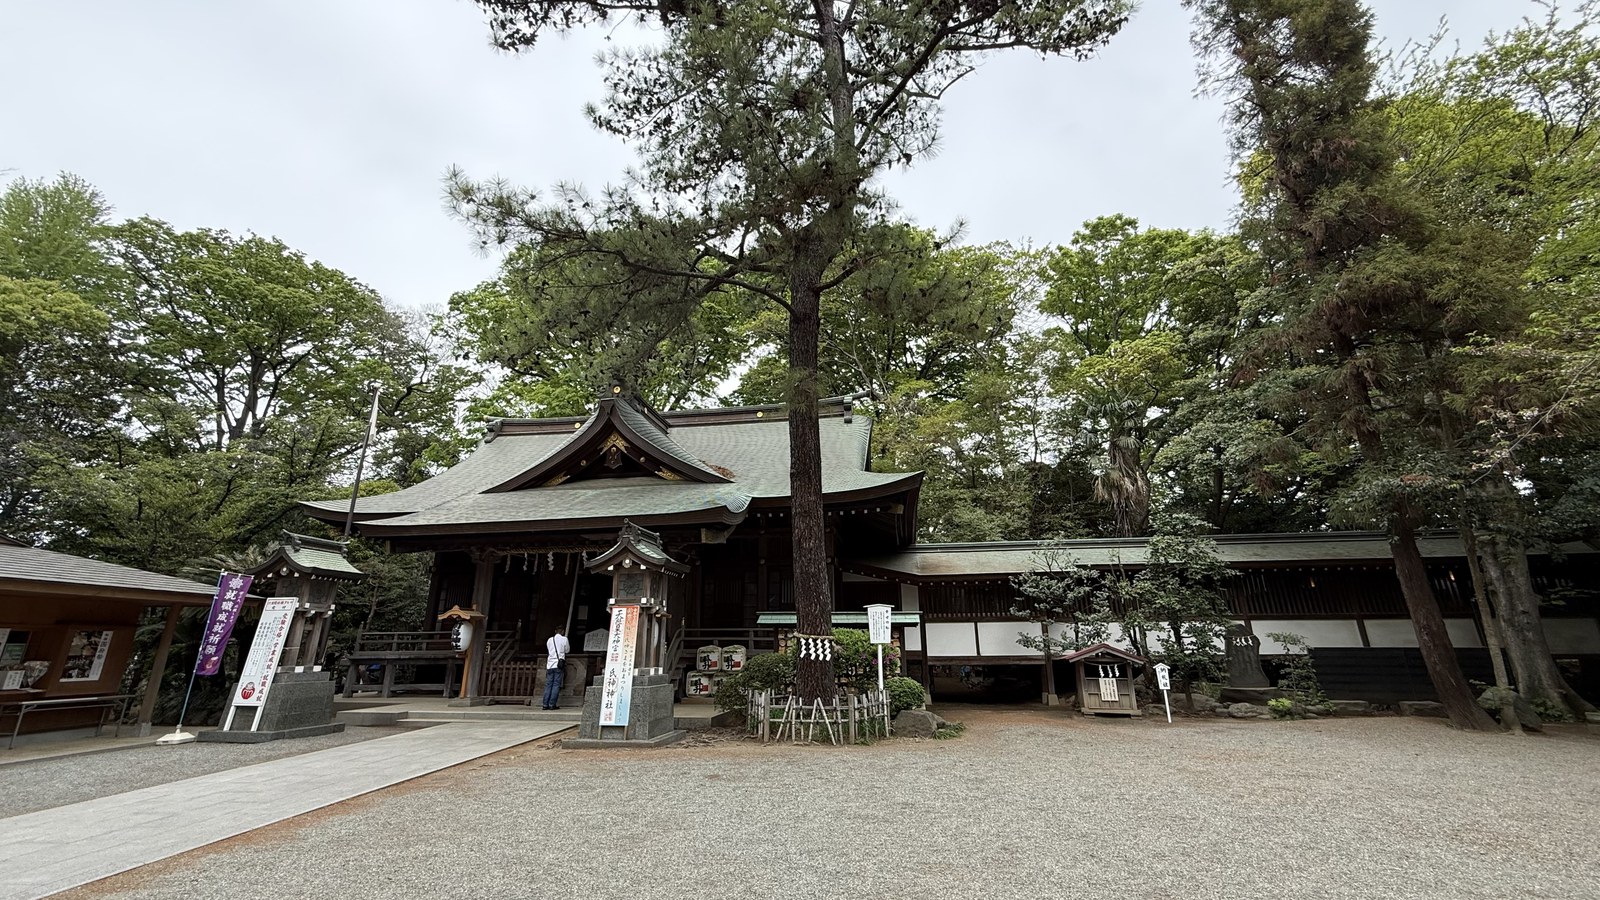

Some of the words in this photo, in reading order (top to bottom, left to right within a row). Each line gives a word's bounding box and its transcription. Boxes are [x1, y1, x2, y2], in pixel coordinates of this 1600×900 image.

[204, 589, 239, 655] 就職成就祈願
[605, 667, 617, 709] 氏神神社
